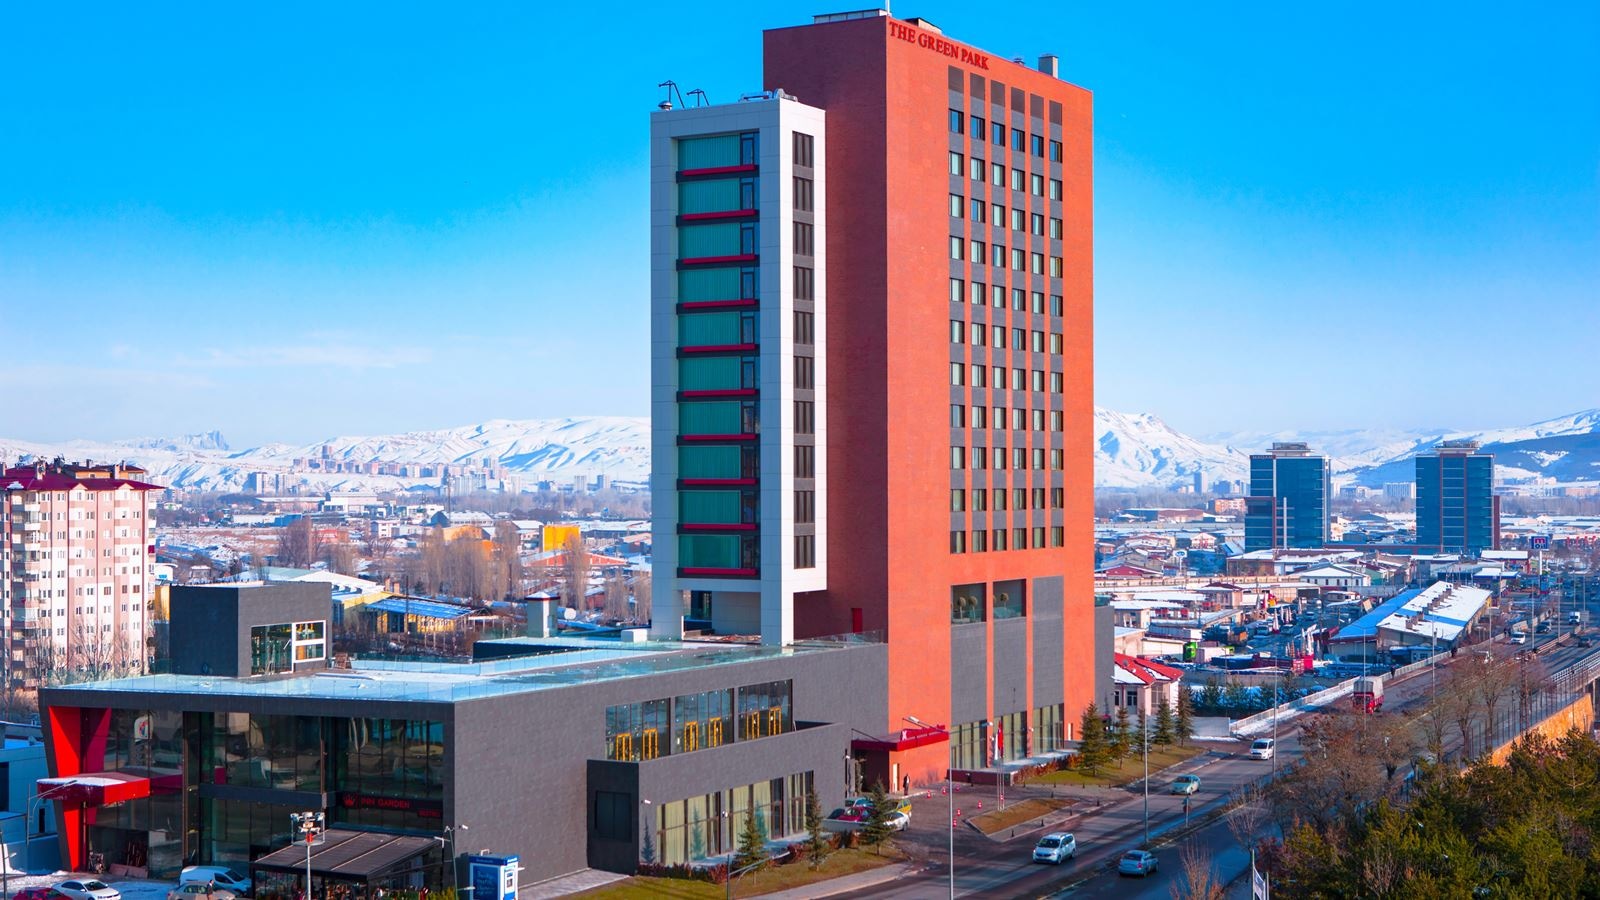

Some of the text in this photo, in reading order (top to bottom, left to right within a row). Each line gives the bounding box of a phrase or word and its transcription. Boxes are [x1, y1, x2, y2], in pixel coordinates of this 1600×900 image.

[889, 22, 989, 70] THE GREEN PARK
